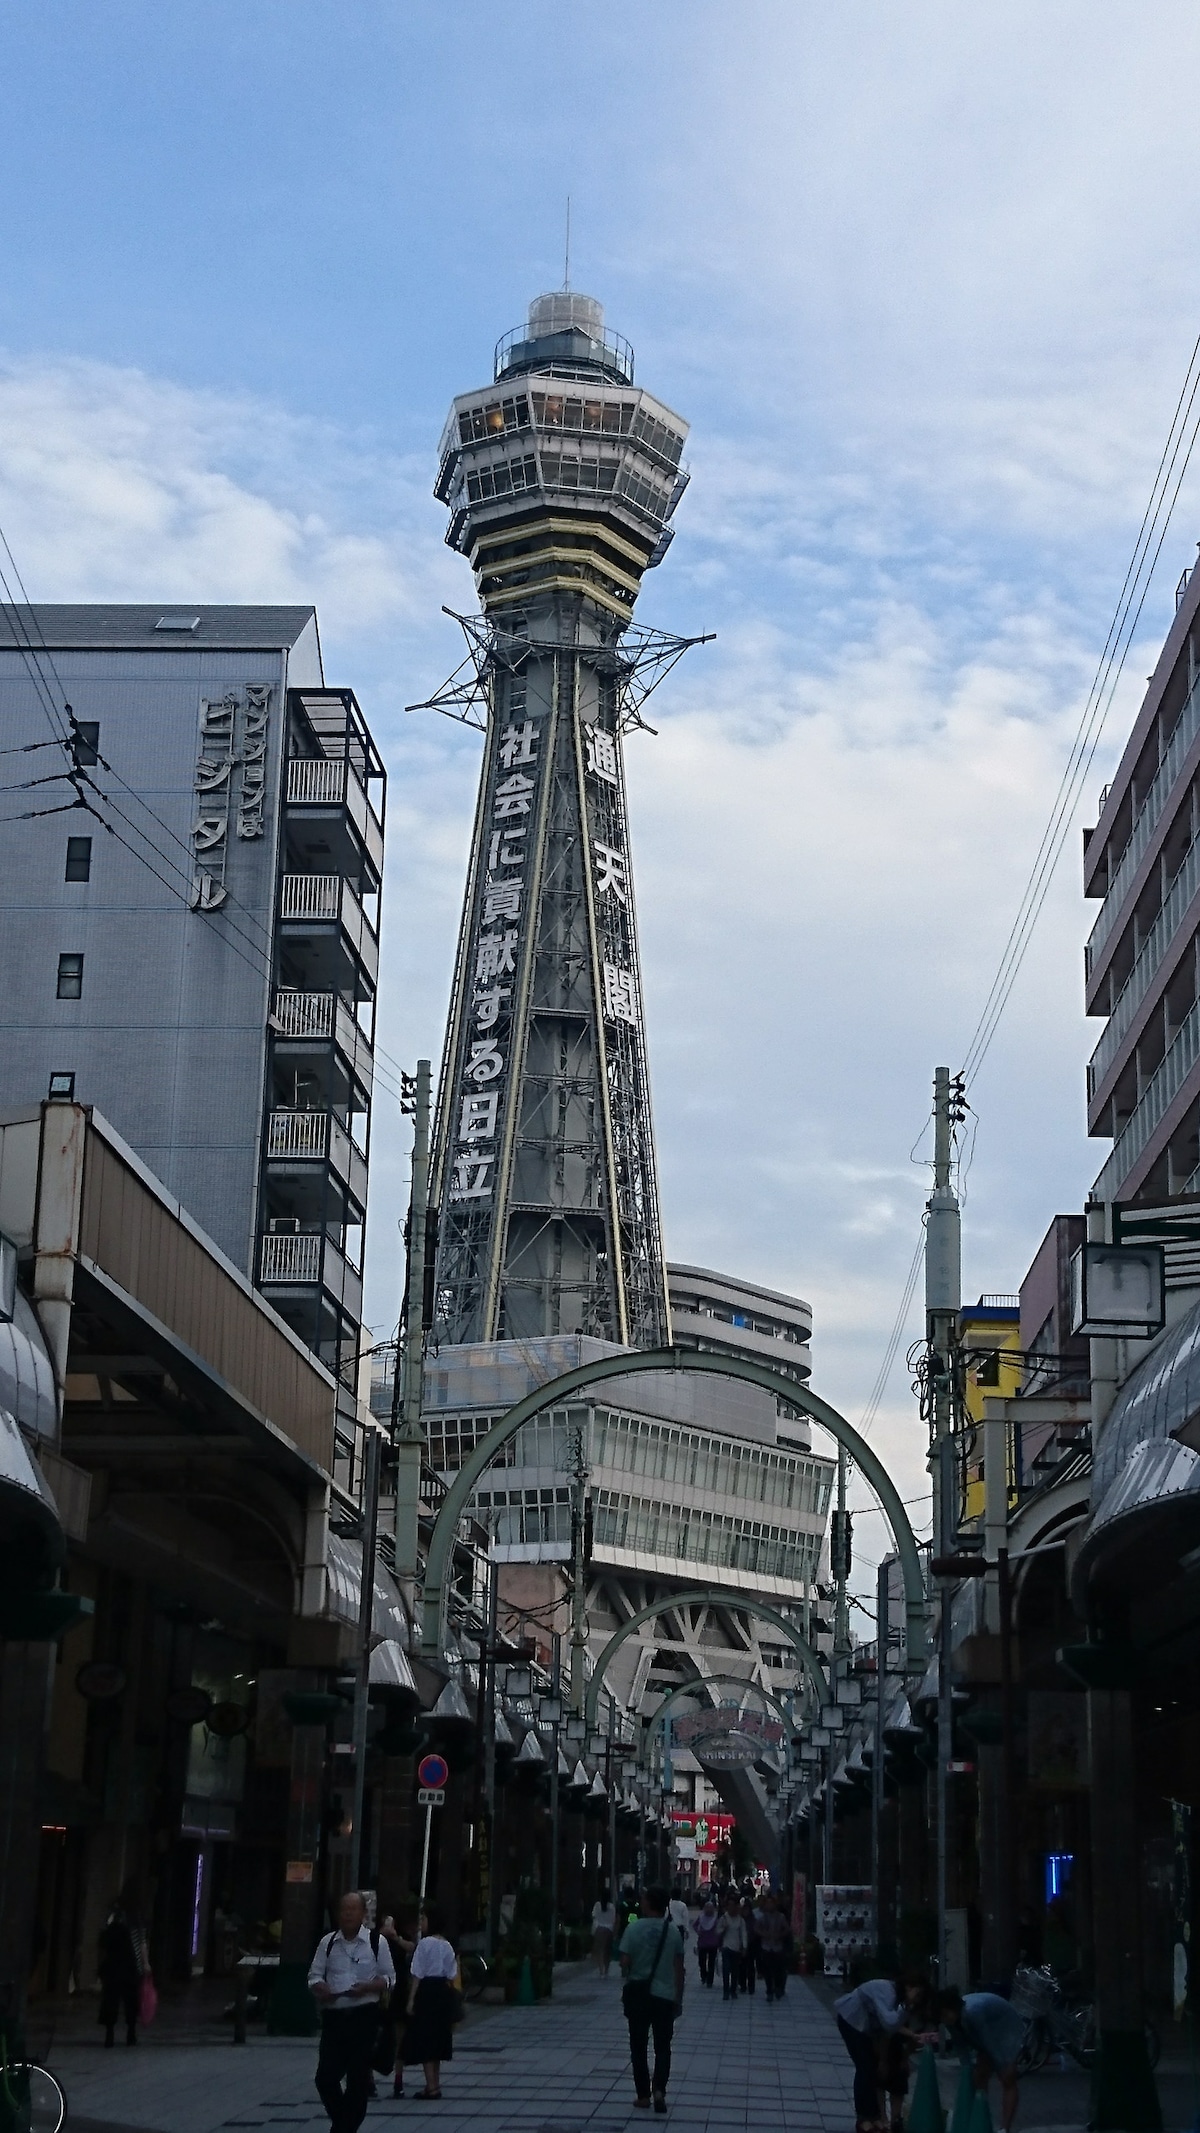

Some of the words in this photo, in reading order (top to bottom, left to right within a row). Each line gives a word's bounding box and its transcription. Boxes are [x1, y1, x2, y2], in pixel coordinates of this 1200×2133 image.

[448, 720, 541, 1202] 社会に貢献する日立
[584, 722, 638, 1026] 通天閣
